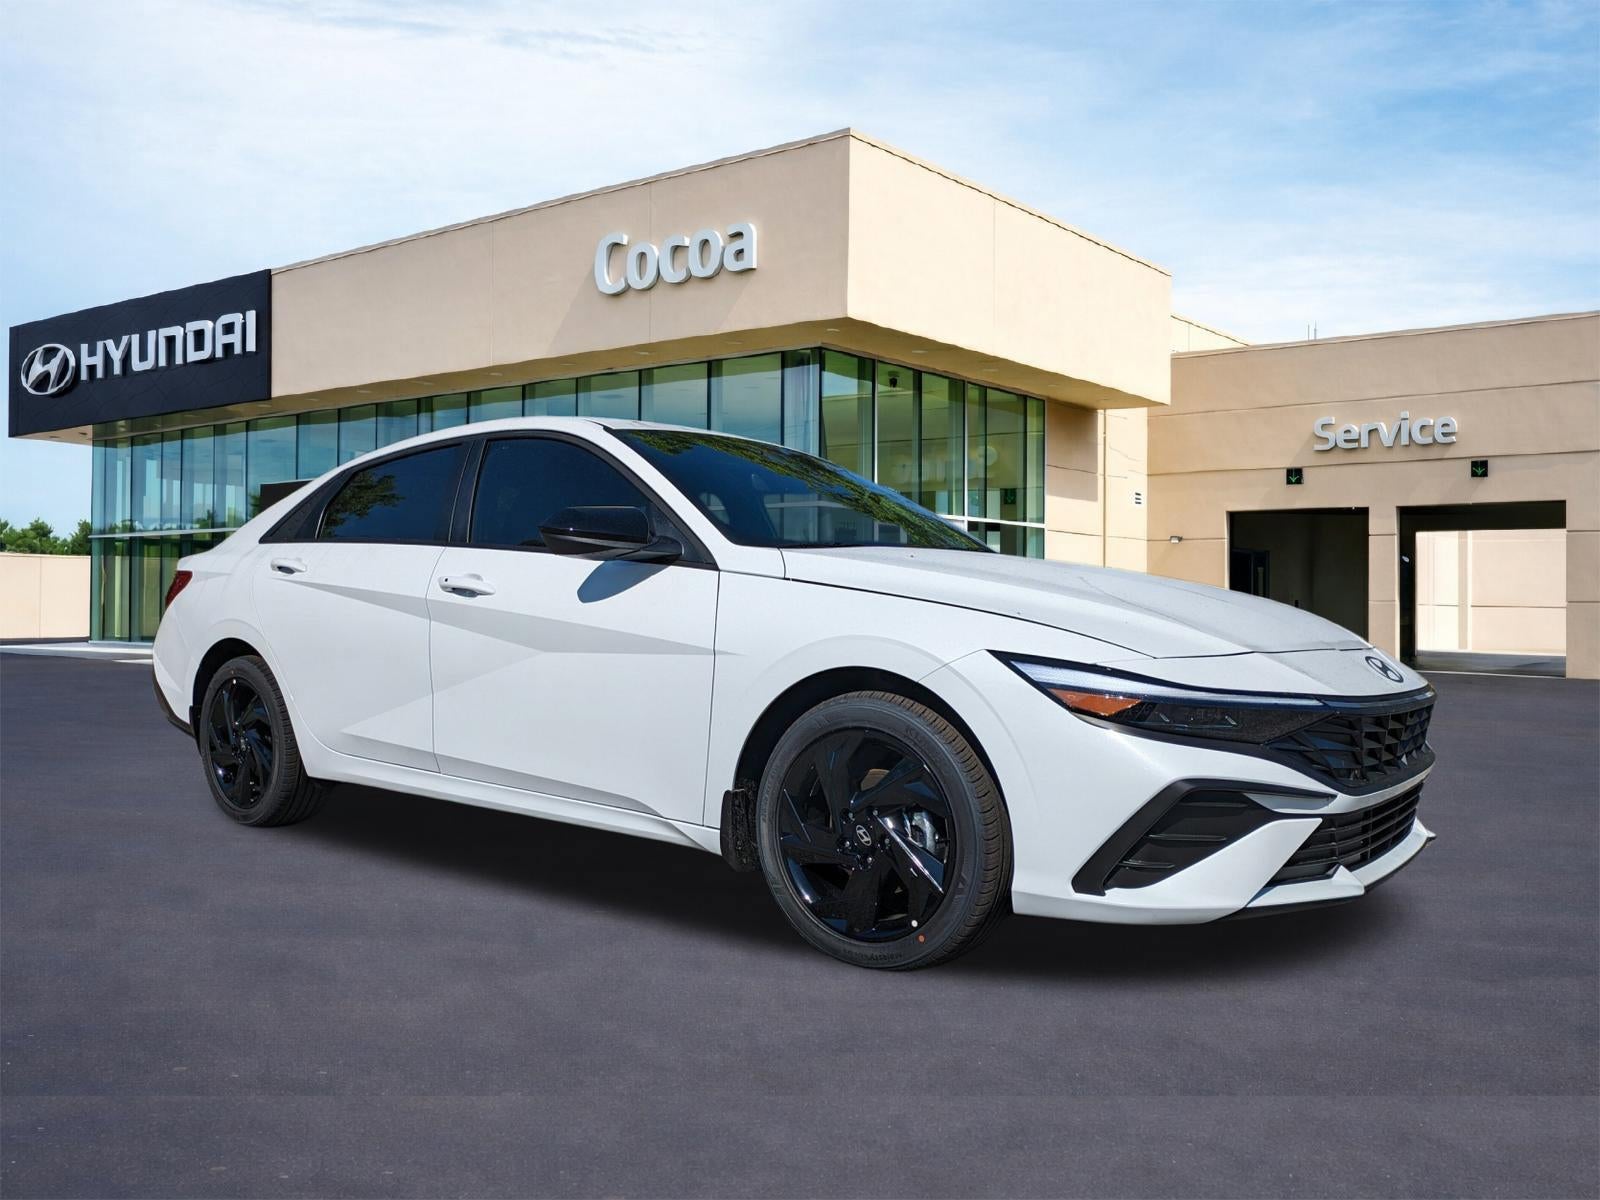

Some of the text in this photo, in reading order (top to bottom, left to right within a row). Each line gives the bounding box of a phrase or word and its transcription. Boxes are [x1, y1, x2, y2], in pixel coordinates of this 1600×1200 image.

[594, 222, 758, 296] Cocoa
[80, 310, 256, 381] HYUNDAI
[1313, 411, 1458, 451] Service
